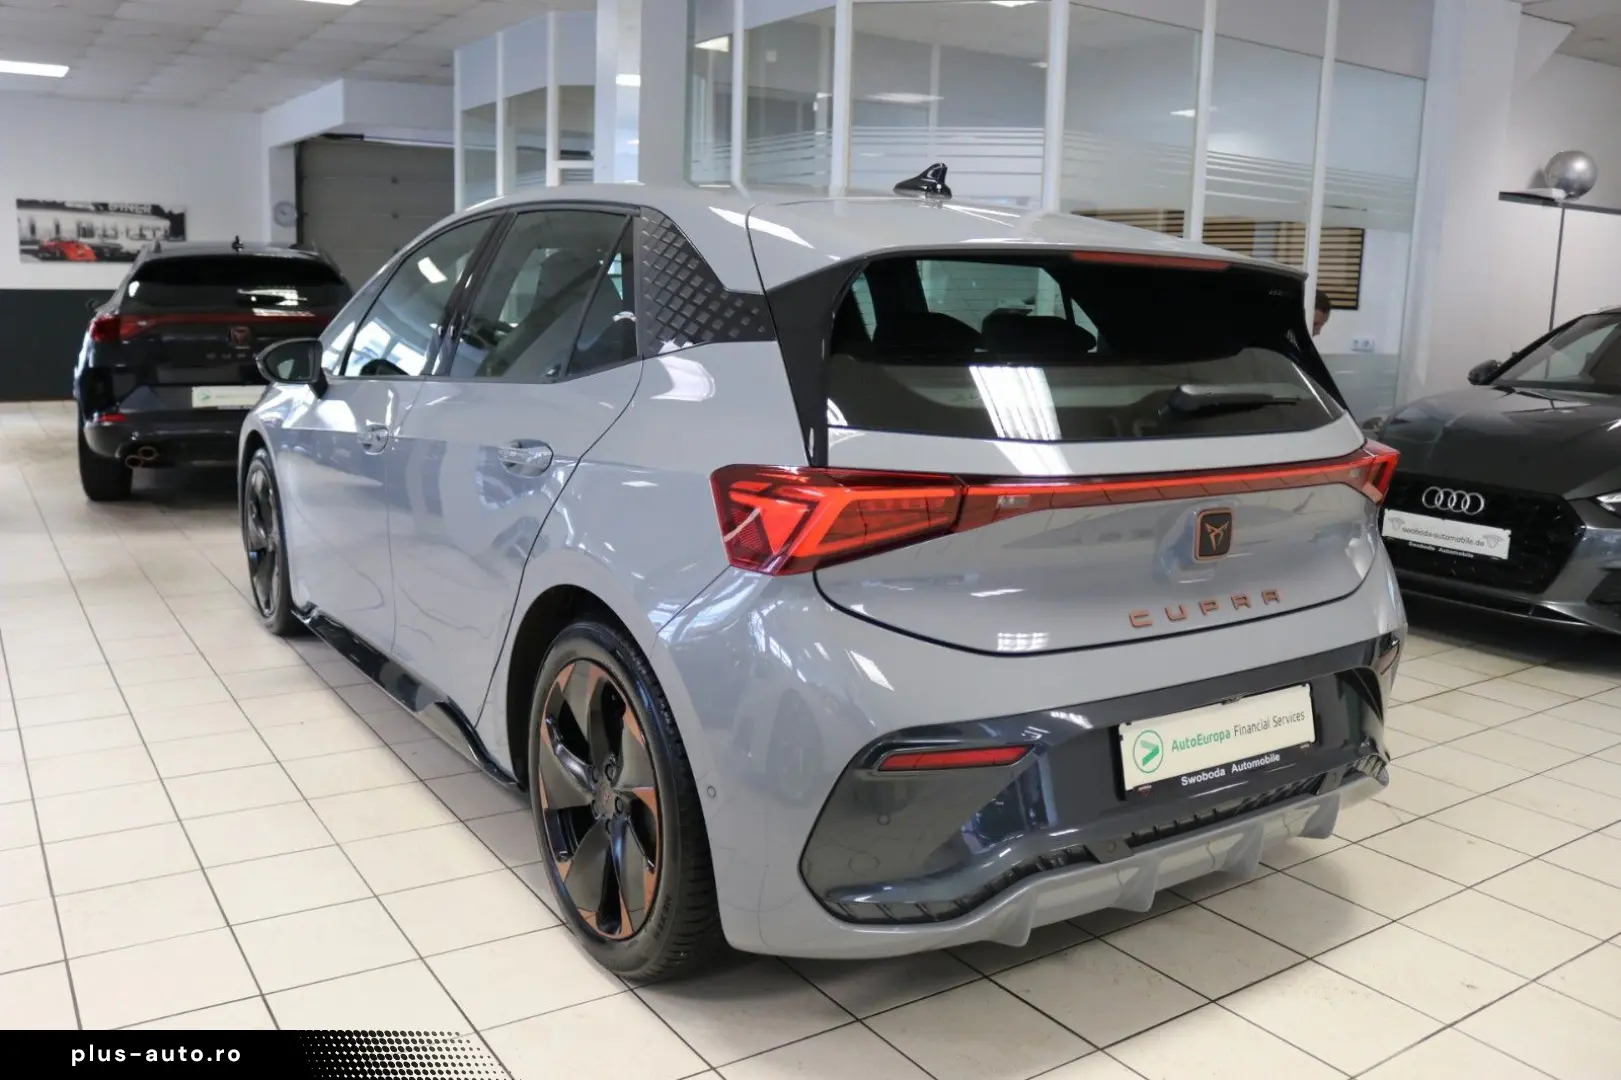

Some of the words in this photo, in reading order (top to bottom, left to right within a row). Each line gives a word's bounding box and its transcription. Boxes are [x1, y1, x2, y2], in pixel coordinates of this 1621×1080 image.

[1438, 547, 1474, 559] Automobile
[1129, 589, 1281, 629] CUPRA
[1171, 728, 1231, 753] AutoEuropa
[1233, 718, 1271, 738] Financial
[1272, 710, 1306, 729] Services
[1181, 767, 1226, 787] Swoboda
[1231, 752, 1281, 774] Automobile
